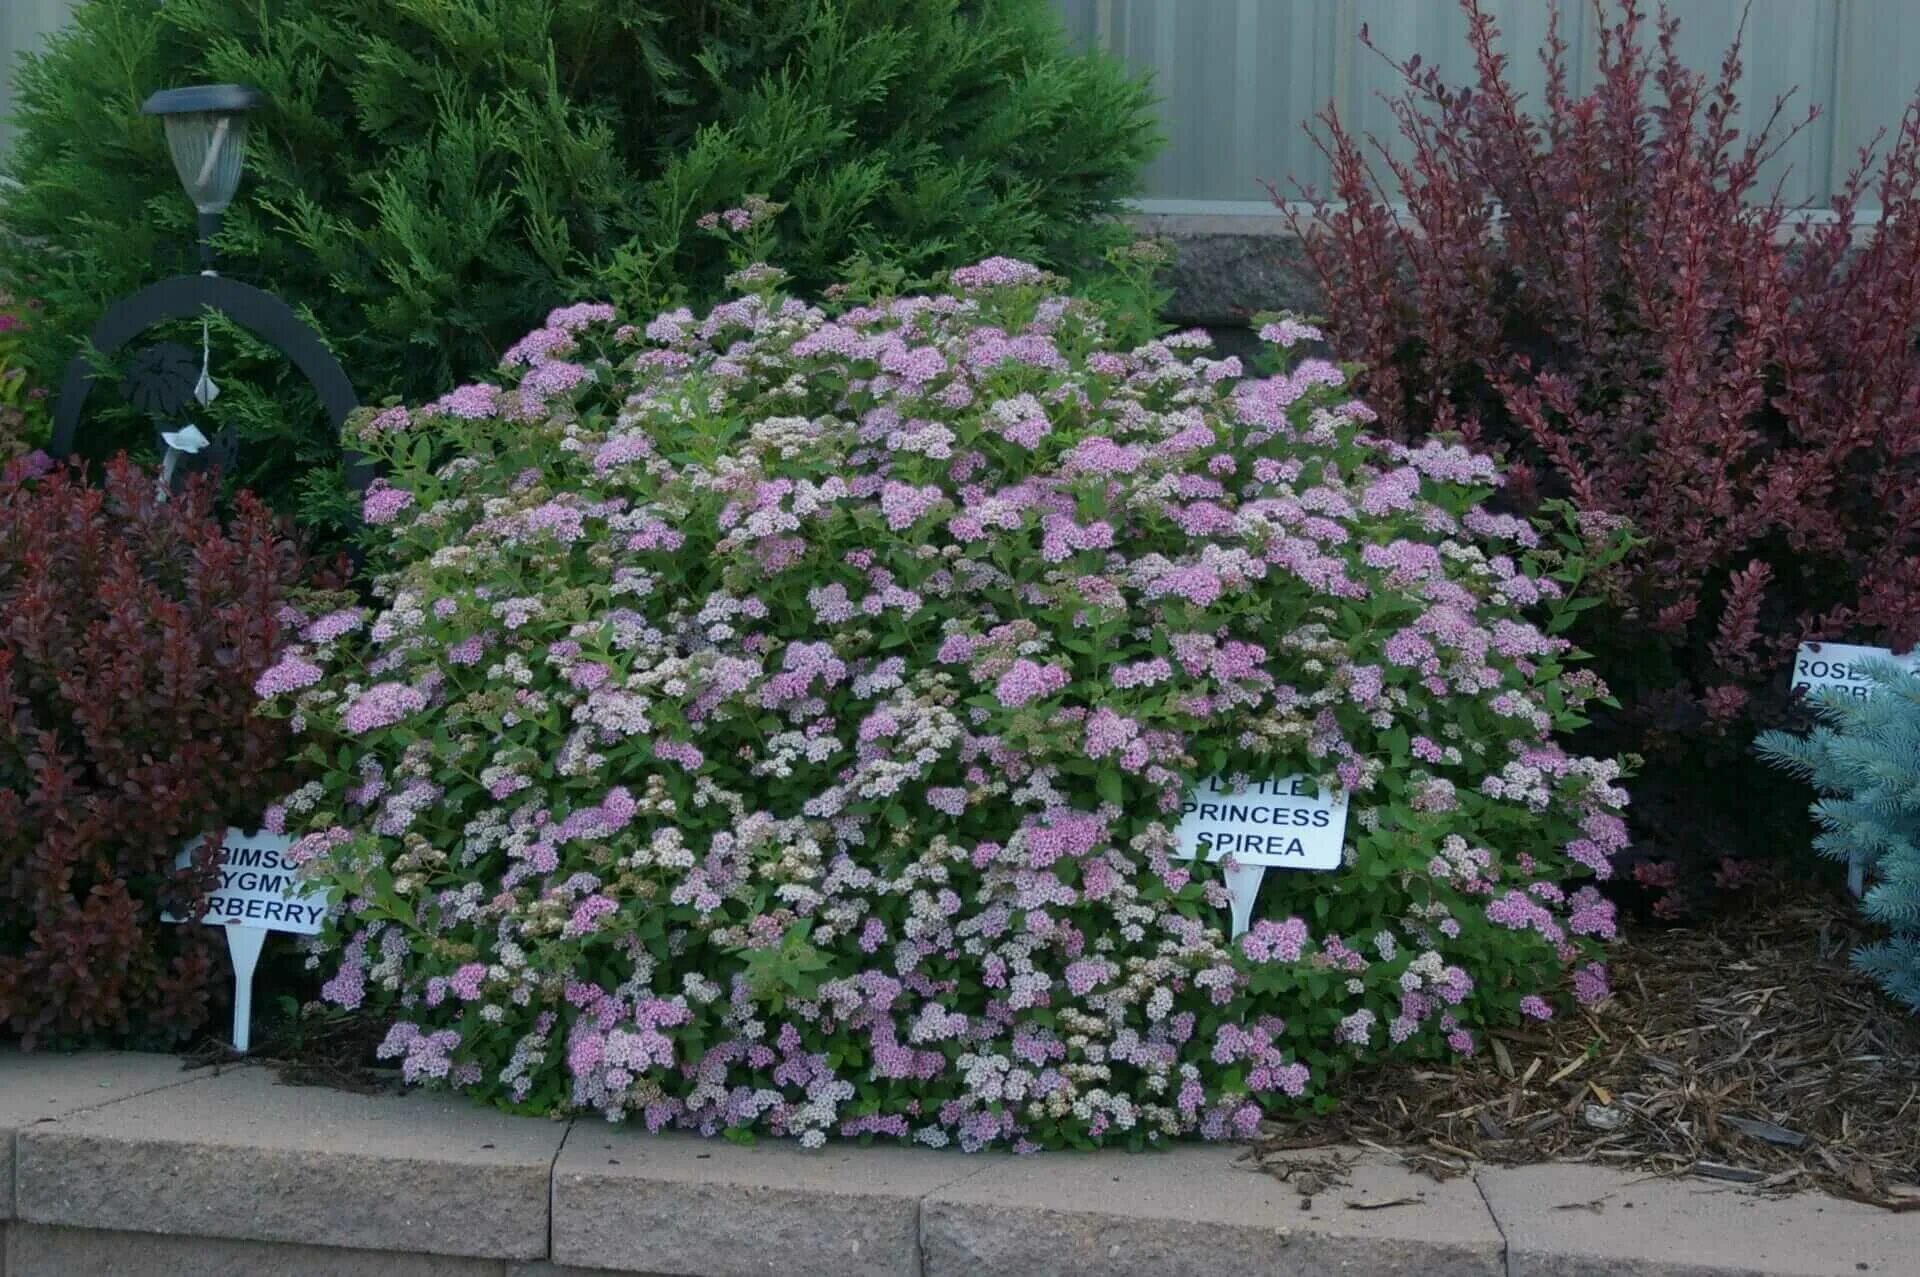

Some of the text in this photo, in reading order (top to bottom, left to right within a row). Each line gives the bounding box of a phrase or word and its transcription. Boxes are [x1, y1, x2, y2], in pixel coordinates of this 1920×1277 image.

[1183, 802, 1330, 828] PRINCESS
[1197, 831, 1306, 857] SPIREA
[207, 896, 324, 925] RBERRY
